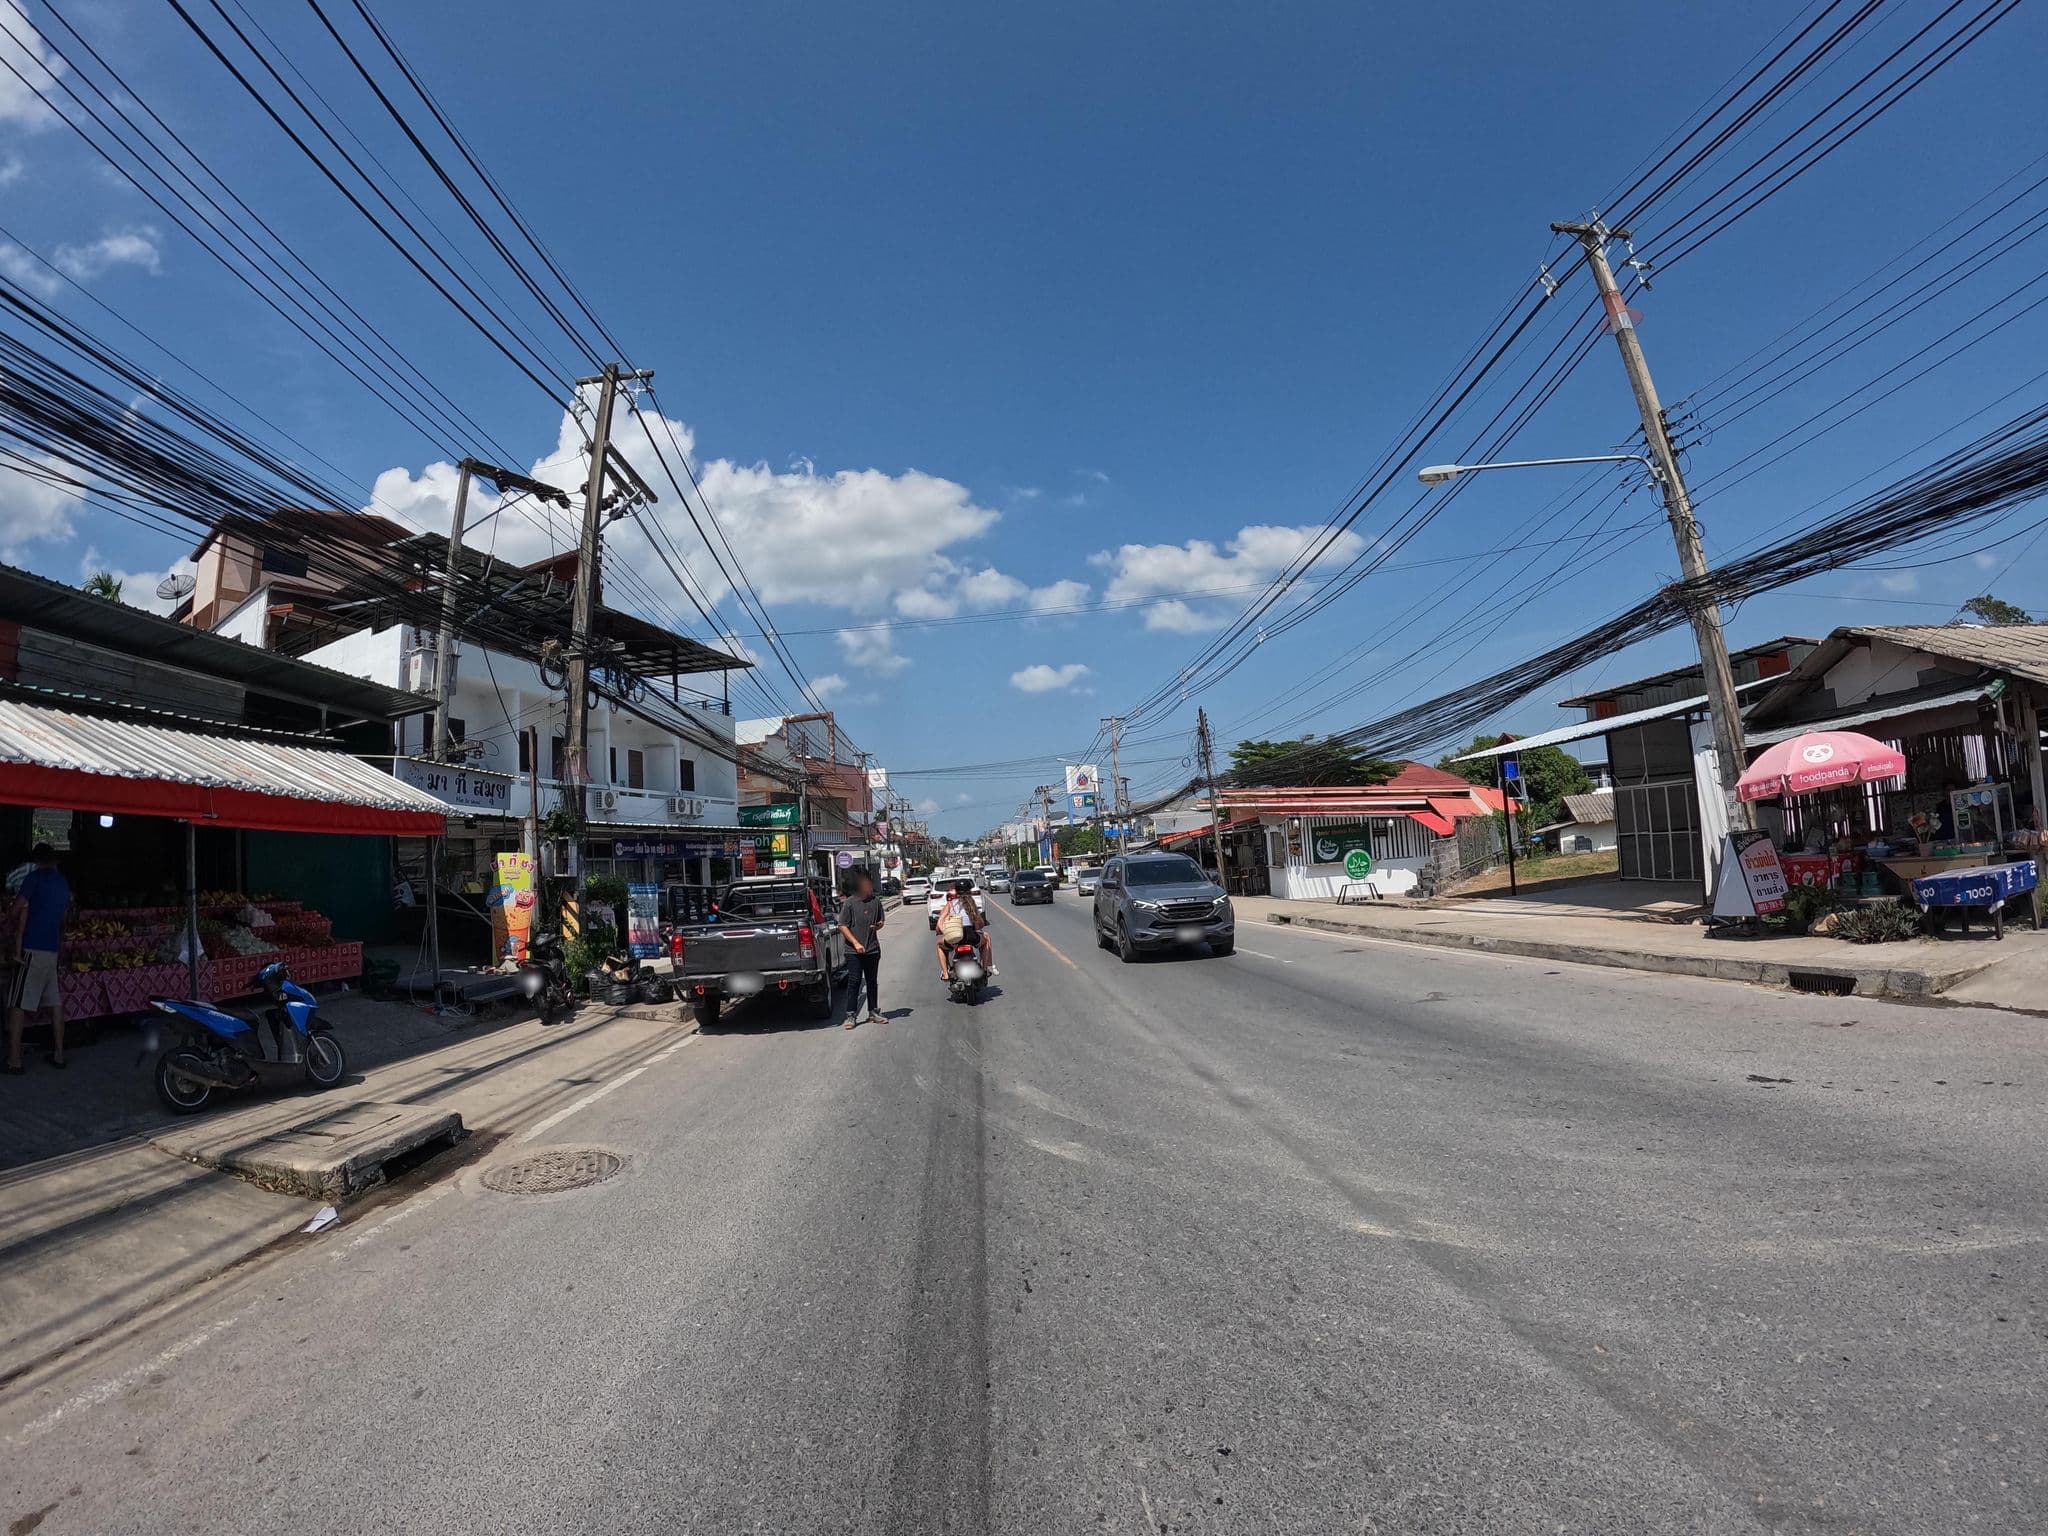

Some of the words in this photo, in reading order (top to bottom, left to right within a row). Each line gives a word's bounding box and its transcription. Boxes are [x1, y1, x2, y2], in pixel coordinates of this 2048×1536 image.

[1799, 766, 1850, 784] foodpanda
[427, 773, 447, 792] มา
[473, 779, 506, 806] สมุย
[1744, 849, 1777, 869] ข้าวมันไก่
[1753, 872, 1780, 883] อาหาร
[1756, 880, 1785, 897] ตามสั่ง
